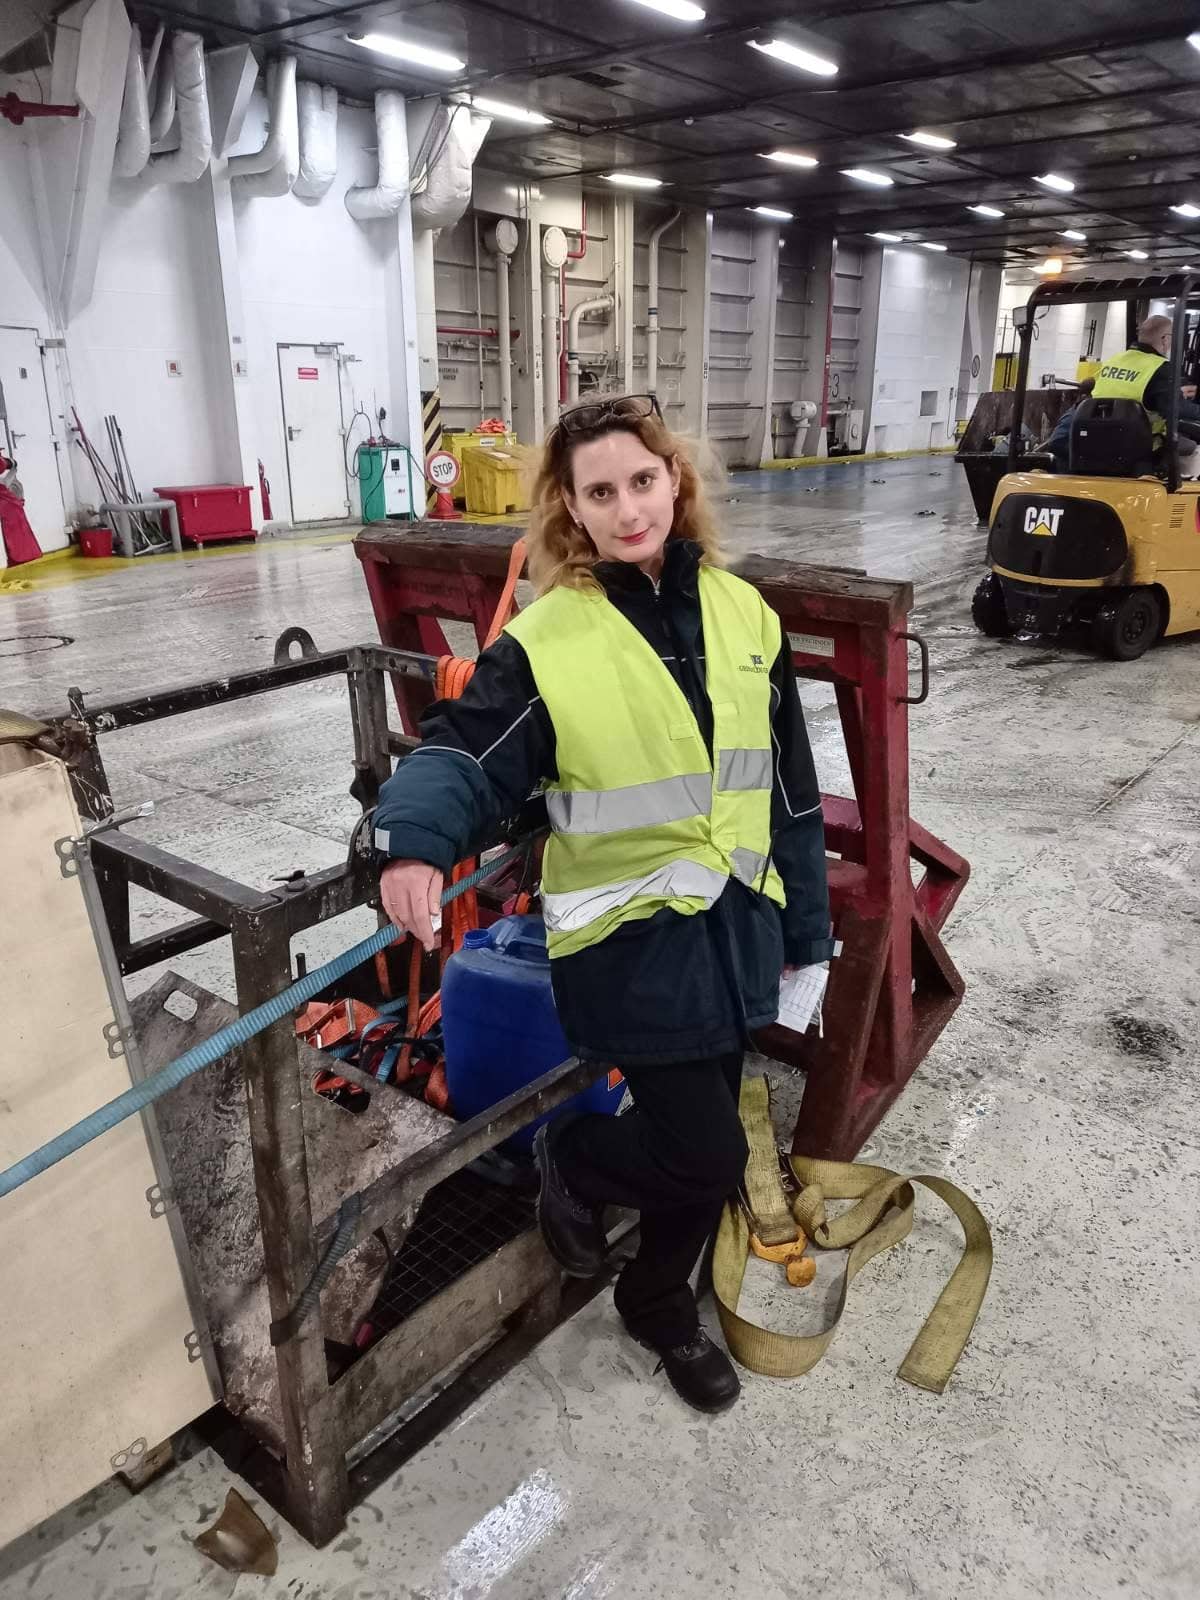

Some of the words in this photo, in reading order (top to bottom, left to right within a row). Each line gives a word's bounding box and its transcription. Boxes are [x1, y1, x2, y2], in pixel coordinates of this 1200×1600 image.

[1101, 366, 1141, 382] CREW
[433, 462, 453, 478] STOP
[1024, 506, 1065, 537] CAT
